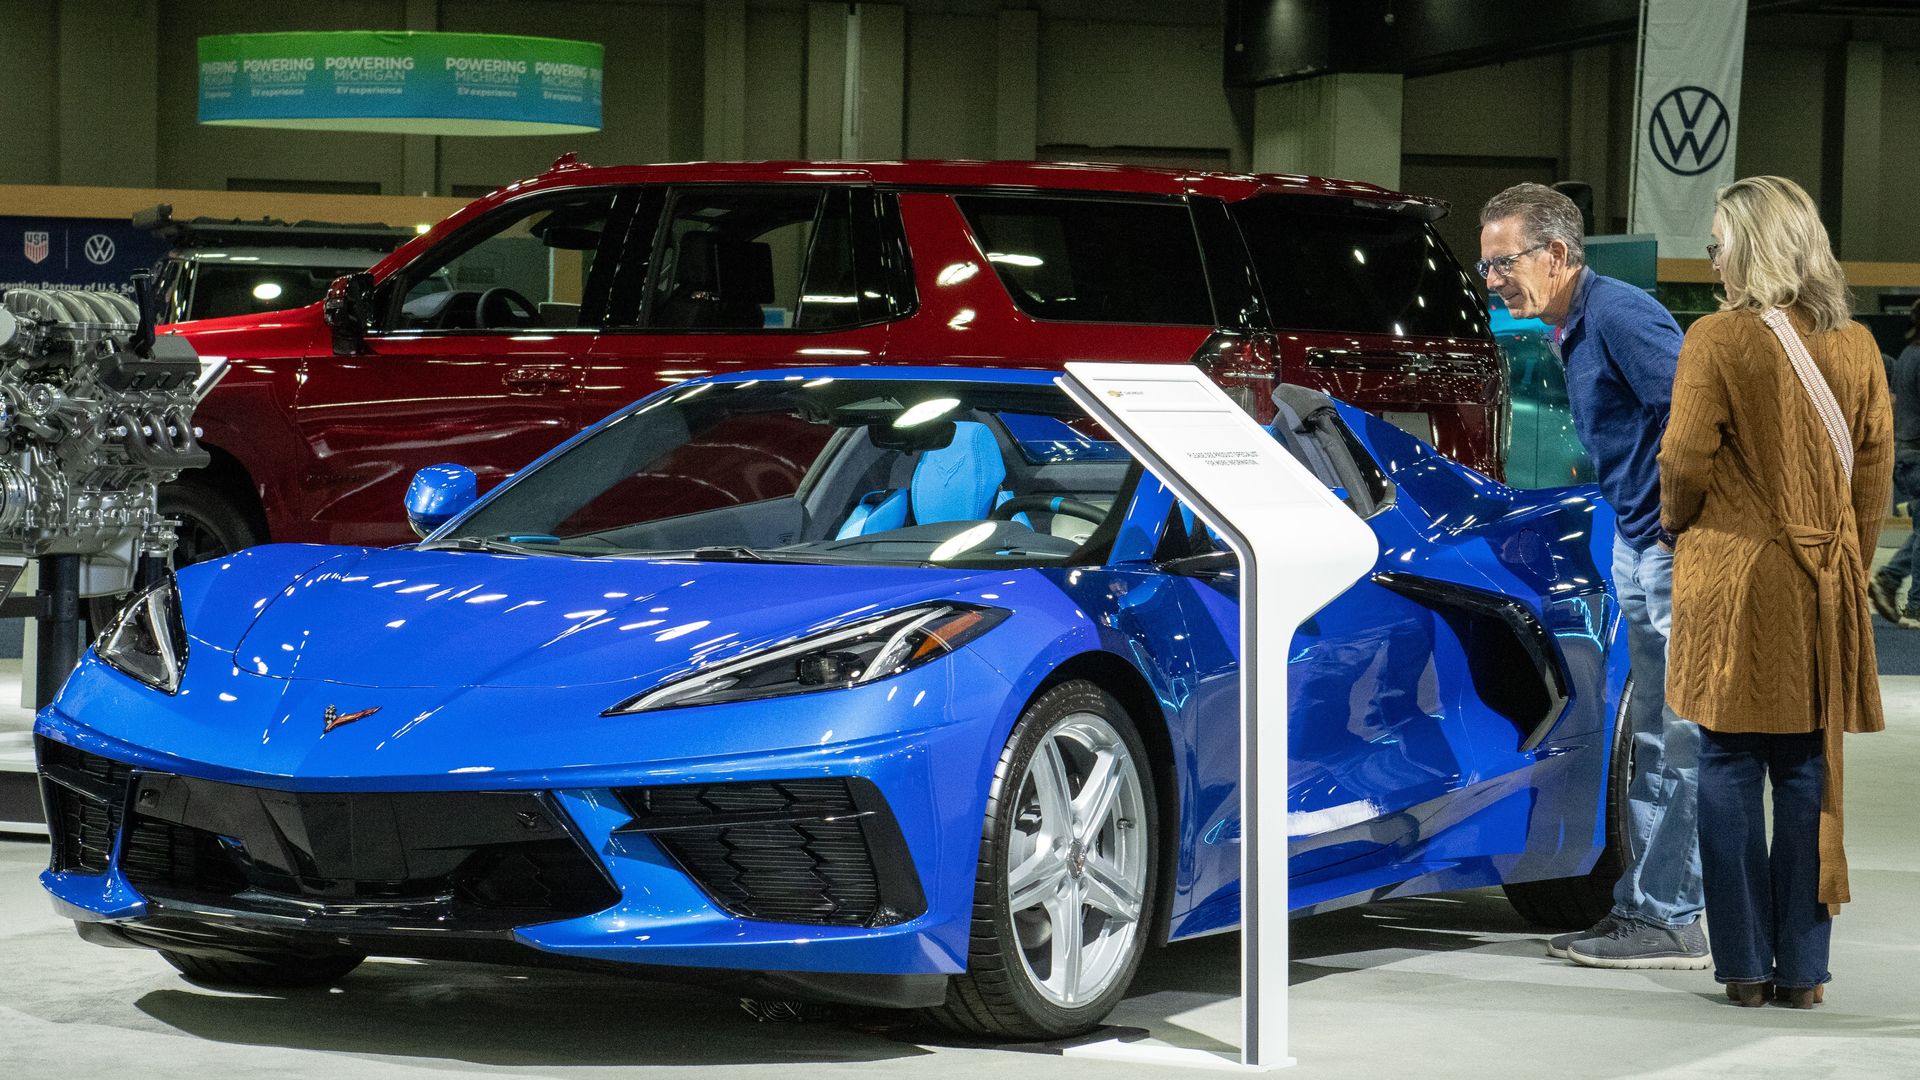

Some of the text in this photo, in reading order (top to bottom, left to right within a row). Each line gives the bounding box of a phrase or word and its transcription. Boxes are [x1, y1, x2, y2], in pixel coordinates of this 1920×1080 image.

[243, 58, 315, 73] POWERING
[325, 57, 414, 70] POWERING
[445, 57, 527, 74] POWERING
[334, 70, 405, 80] MICHIGAN
[455, 71, 519, 83] MICHIGAN
[336, 86, 402, 95] EV experience
[458, 87, 517, 98] EV experience
[42, 281, 82, 291] Partner
[84, 282, 95, 292] of
